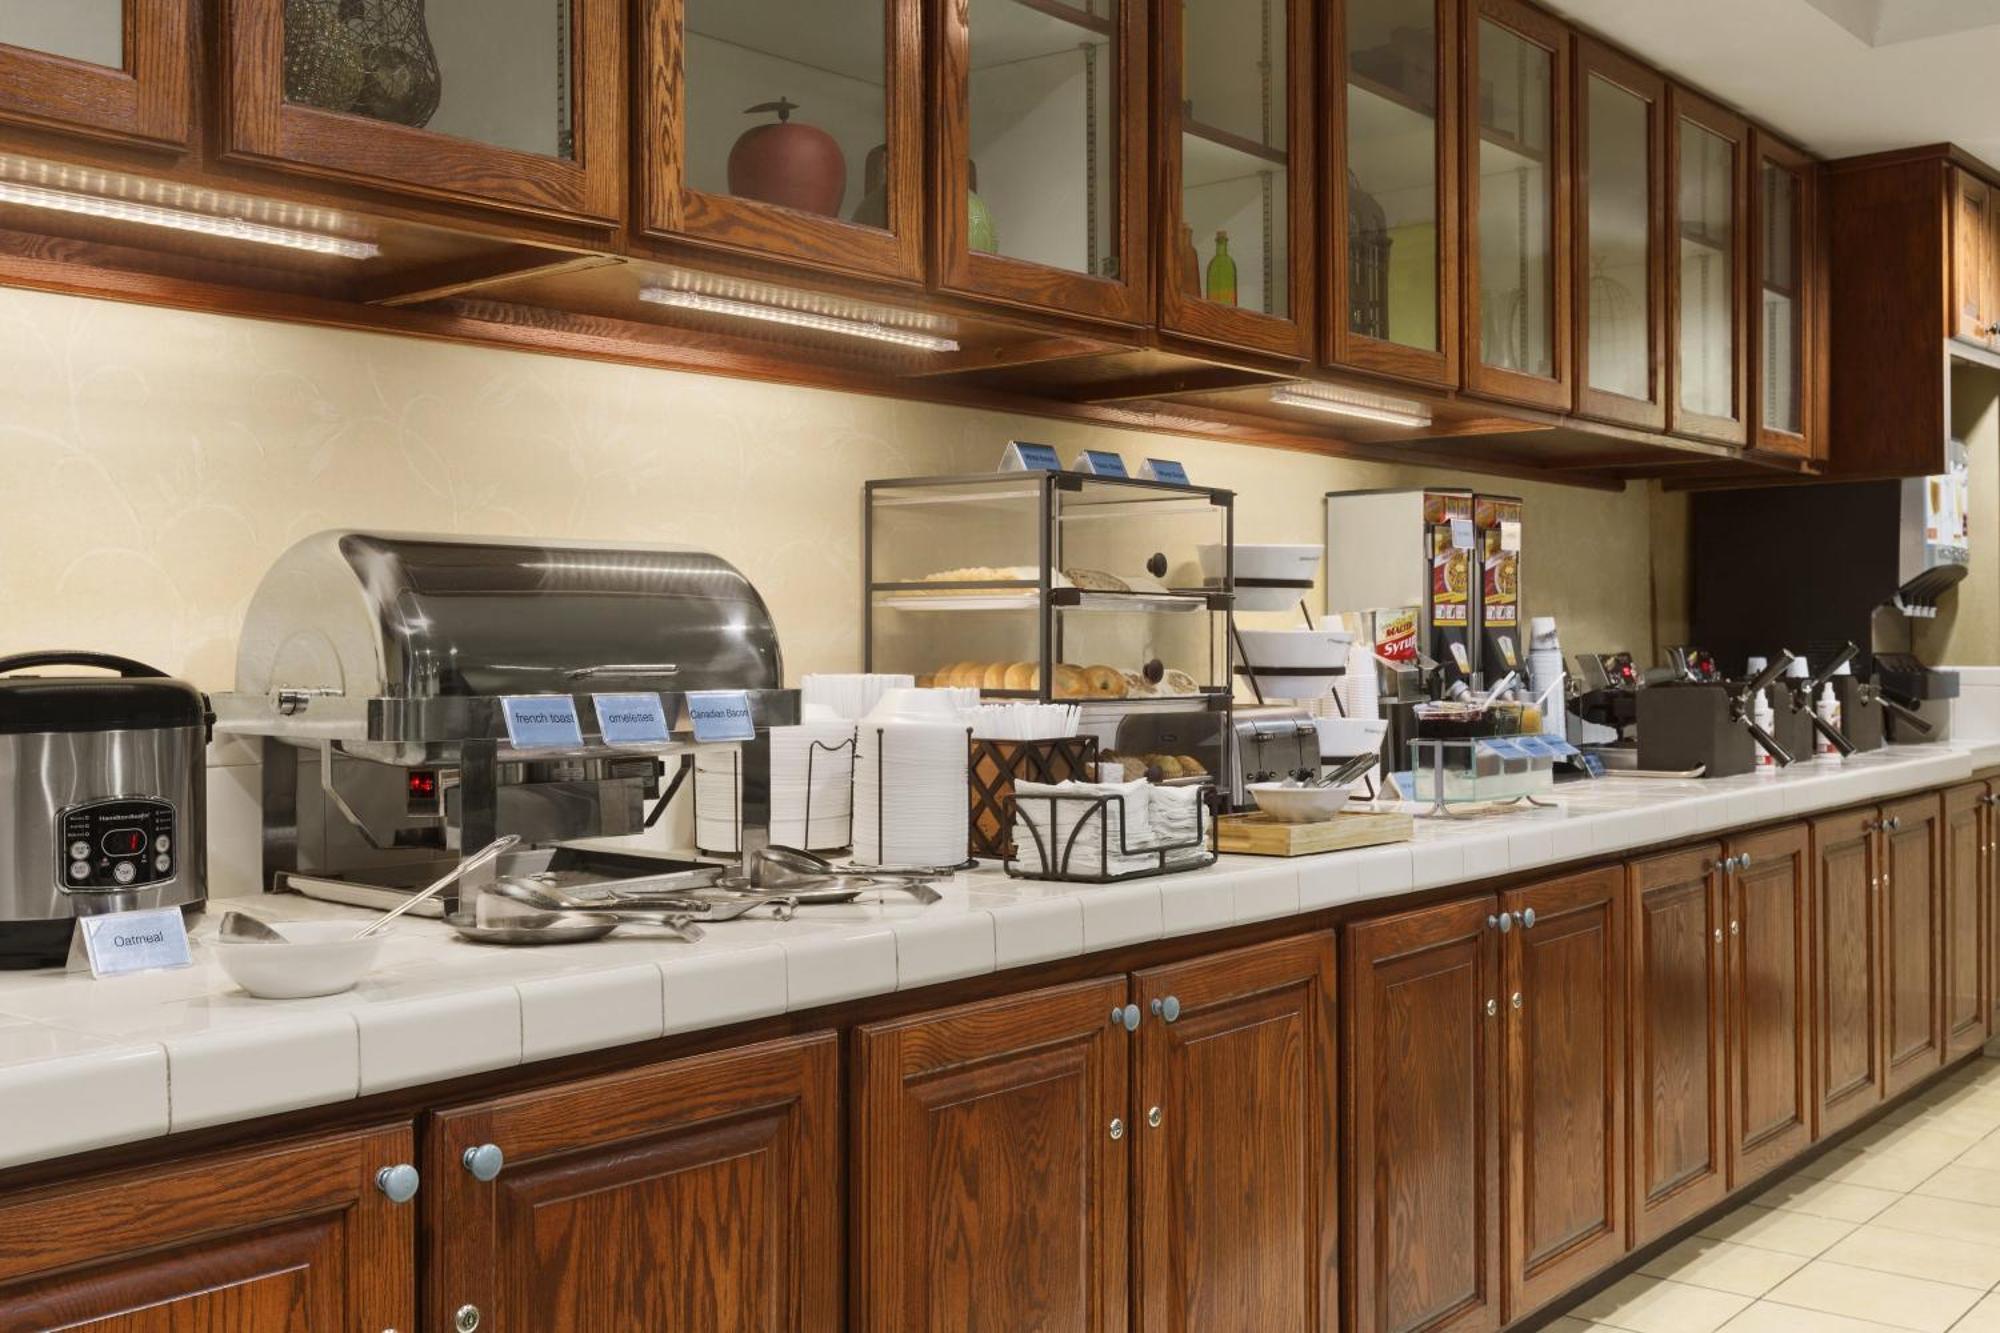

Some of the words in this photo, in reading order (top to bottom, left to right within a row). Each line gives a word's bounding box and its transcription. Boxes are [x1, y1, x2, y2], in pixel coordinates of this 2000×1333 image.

[1383, 635, 1416, 656] Syrup
[515, 712, 548, 724] french
[550, 712, 575, 723] toast
[608, 712, 655, 723] omelettes
[690, 709, 726, 720] Canadian
[726, 708, 748, 718] Bacon
[114, 930, 164, 947] Oatmeal
